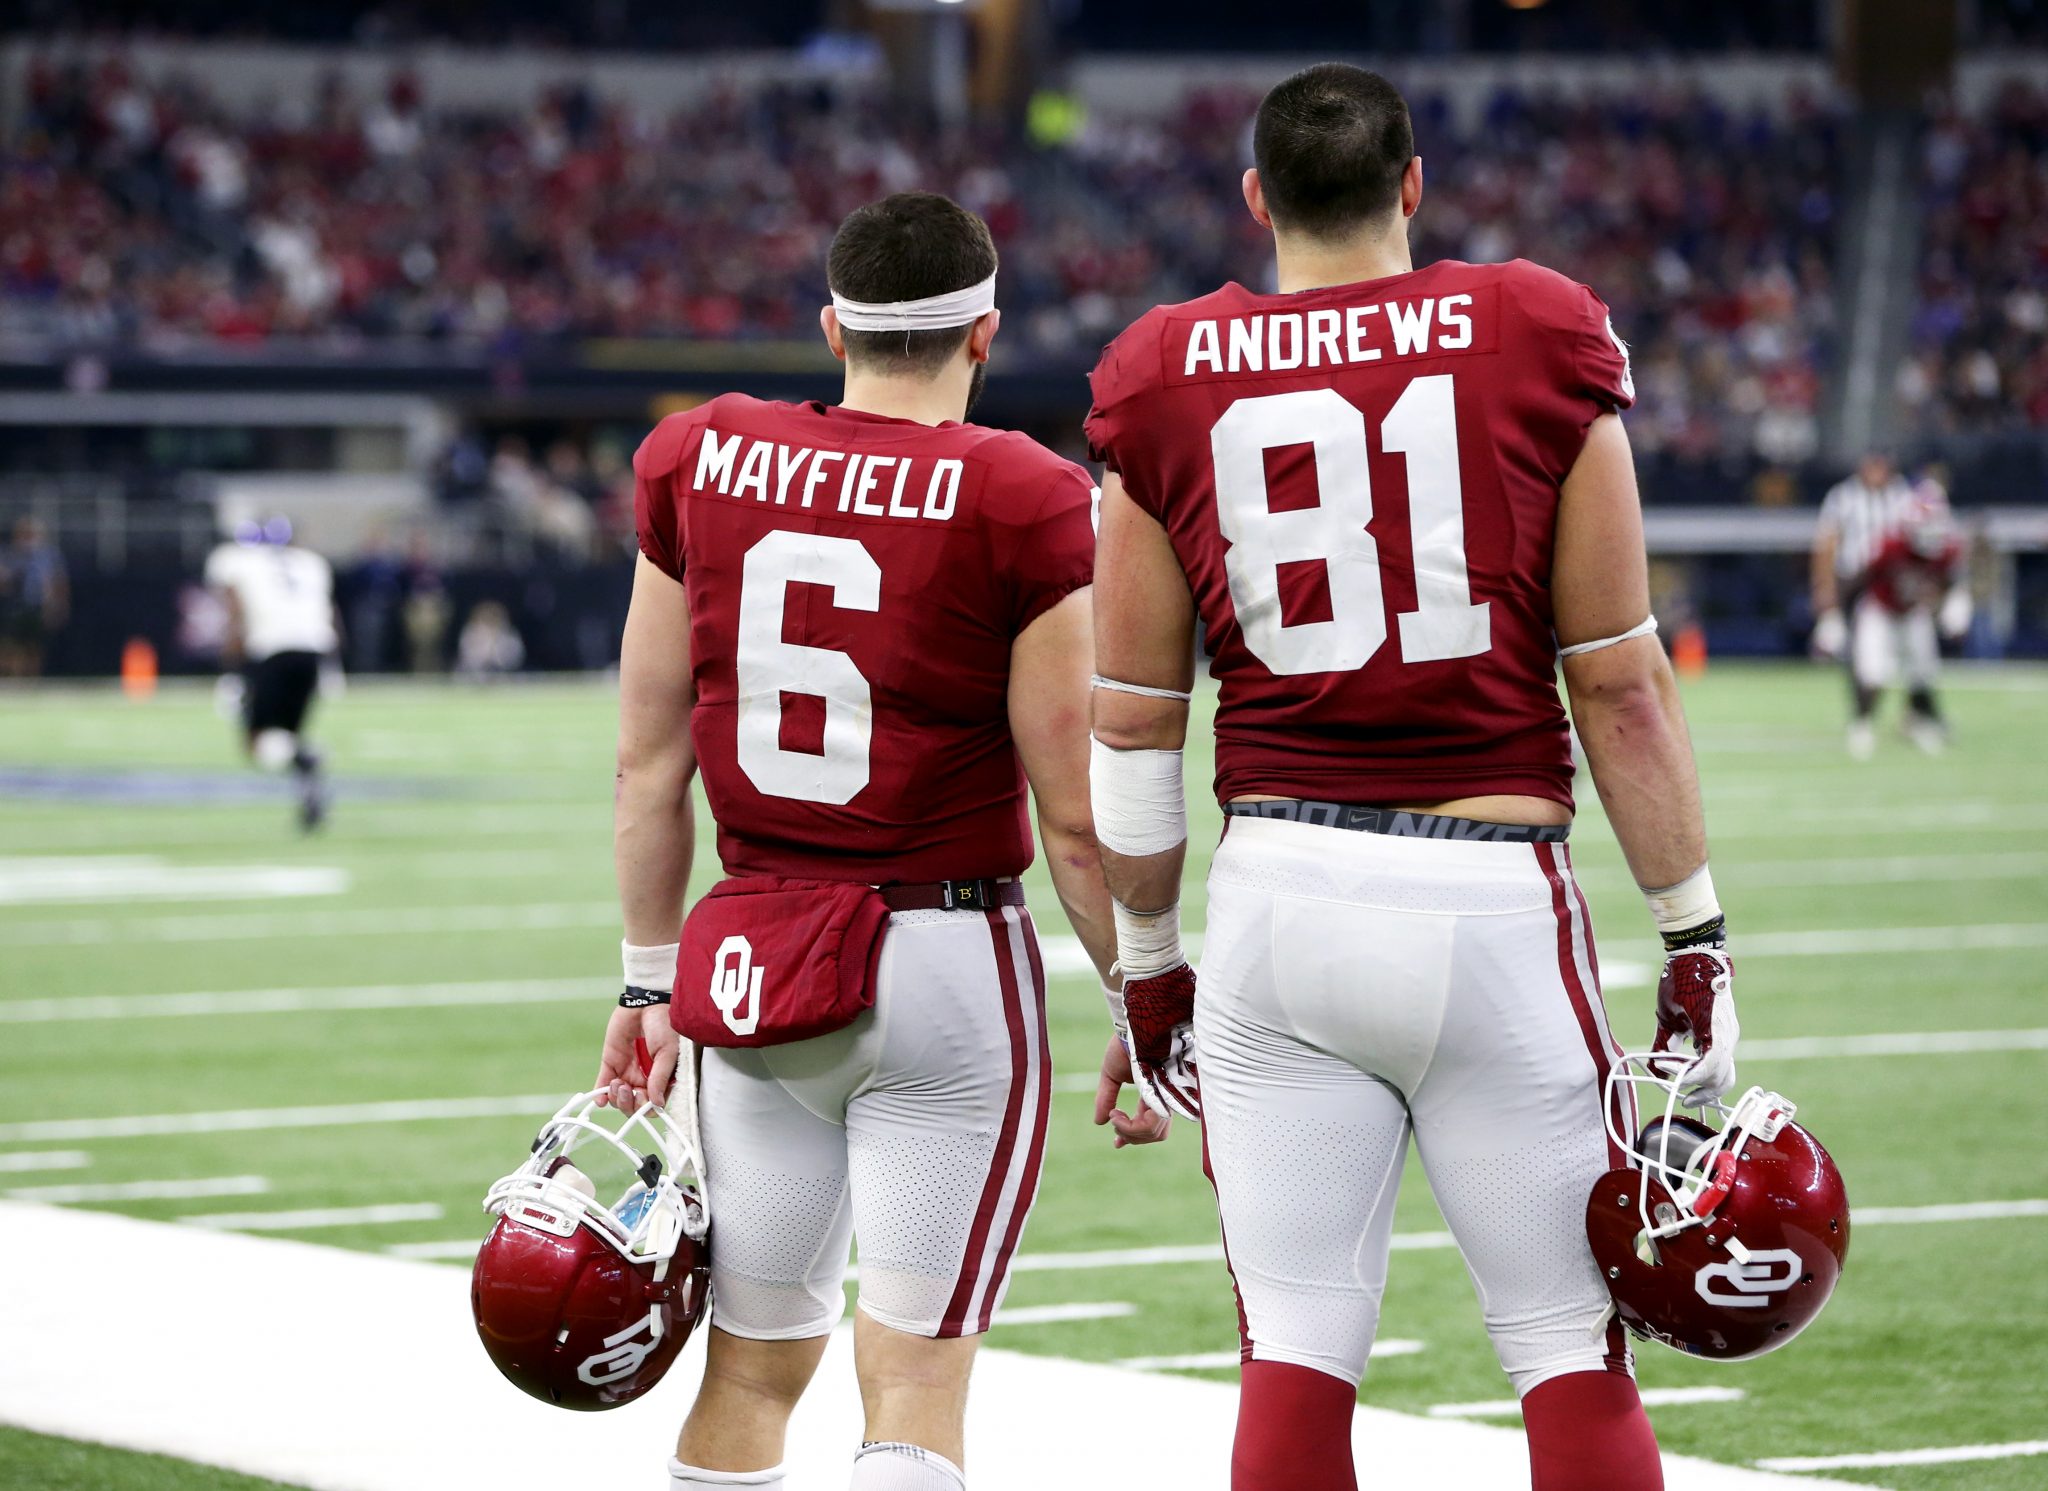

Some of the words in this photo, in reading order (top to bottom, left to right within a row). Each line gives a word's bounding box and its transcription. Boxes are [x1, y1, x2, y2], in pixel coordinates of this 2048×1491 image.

[1184, 294, 1473, 376] ANDREWS
[692, 428, 964, 521] MAYFIELD
[1210, 373, 1492, 676] 81
[736, 529, 882, 806] 6
[710, 934, 766, 1036] OU
[1695, 1247, 1803, 1307] OU
[576, 1312, 666, 1386] OU
